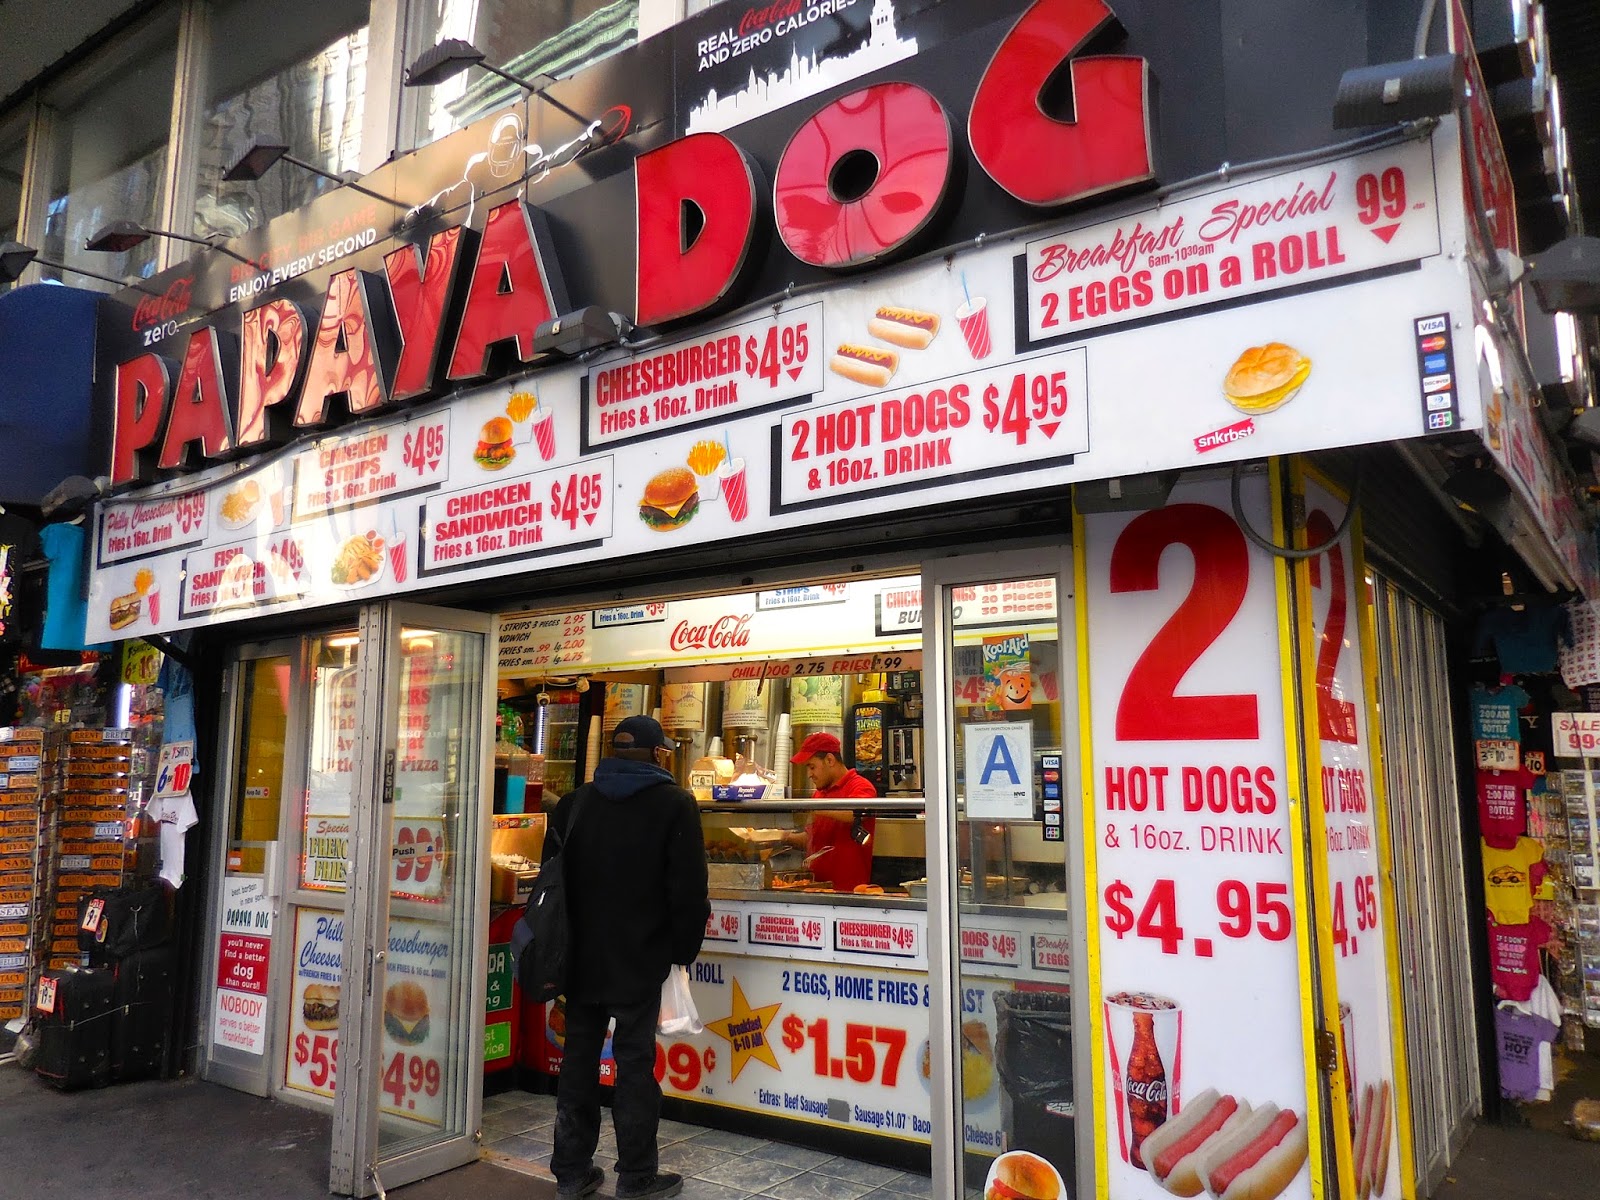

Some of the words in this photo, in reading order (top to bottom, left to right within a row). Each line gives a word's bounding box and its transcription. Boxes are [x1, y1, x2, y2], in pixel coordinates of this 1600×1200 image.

[698, 47, 730, 71] AND
[731, 28, 772, 58] ZERO
[775, 0, 857, 36] CALORIES
[698, 27, 738, 56] REAL
[1356, 167, 1407, 226] 99
[1032, 216, 1185, 283] Breakfast
[1199, 171, 1338, 242] Special
[110, 202, 557, 486] PAPAYA
[634, 0, 1155, 327] DOG
[229, 271, 272, 303] ENJOY
[272, 251, 316, 286] EVERY
[318, 228, 377, 265] SECOND
[1040, 293, 1059, 329] 2
[1069, 270, 1154, 322] EGGS
[1163, 263, 1209, 300] on
[1220, 256, 1243, 288] a
[1252, 226, 1346, 281] ROLL
[1421, 320, 1444, 331] VISA
[596, 335, 741, 408] CHEESEBURGER
[600, 409, 636, 435] Fries
[639, 406, 650, 426] &
[653, 395, 691, 422] 16oz.
[695, 380, 738, 412] Drink
[791, 419, 810, 461] 2
[816, 404, 876, 456] HOT
[881, 383, 971, 443] DOGS
[1199, 423, 1254, 448] snkrbst
[319, 434, 388, 469] CHICKEN
[325, 457, 381, 487] STRIPS
[807, 468, 821, 491] &
[826, 457, 878, 487] 16oz.
[884, 437, 952, 477] DRINK
[307, 487, 332, 507] Fries
[343, 480, 367, 500] 16oz.
[369, 472, 397, 494] Drink
[446, 481, 531, 518] CHICKEN
[107, 511, 129, 534] Philly
[435, 502, 543, 542] SANDWICH
[108, 536, 126, 555] Fries
[127, 536, 132, 549] &
[152, 523, 173, 546] Drink
[433, 540, 462, 562] Fries
[465, 540, 474, 556] &
[476, 534, 505, 554] 16oz.
[508, 525, 543, 547] Drink
[214, 547, 244, 568] FISH
[192, 561, 266, 591] SANDWICH
[1002, 579, 1052, 591] Pieces
[190, 590, 210, 607] Fries
[765, 597, 781, 605] Fries
[803, 593, 820, 602] Drink
[982, 595, 998, 604] 20
[1002, 591, 1053, 602] Pieces
[600, 613, 612, 623] Fries
[630, 609, 644, 619] Drink
[982, 606, 998, 615] 30
[1002, 603, 1053, 613] Pieces
[503, 620, 532, 632] STRIPS
[532, 620, 539, 630] 3
[540, 619, 561, 628] PIECES
[1110, 502, 1260, 742] 2
[1308, 509, 1358, 745] 2
[670, 613, 754, 653] Coca-Cola
[499, 645, 523, 656] FRIES
[553, 641, 562, 653] lg.
[563, 639, 585, 650] 2.00
[983, 633, 1030, 661] Kool-Aid
[498, 657, 520, 667] FRIES
[732, 665, 761, 679] CHILI
[795, 661, 825, 675] 2.75
[831, 658, 871, 672] FRIES
[1496, 710, 1510, 719] AM
[1482, 724, 1508, 733] BOTTLE
[1560, 720, 1600, 731] SALE
[400, 760, 439, 772] Pizza
[979, 735, 1021, 785] A
[157, 765, 169, 793] 6
[172, 763, 191, 792] 10
[384, 752, 394, 798] PUSH
[1105, 766, 1169, 812] HOT
[1182, 765, 1276, 815] DOGS
[1339, 768, 1367, 814] DOGS
[1486, 791, 1501, 799] 2:00
[1503, 791, 1515, 800] AM
[1489, 806, 1514, 815] BOTTLE
[1105, 824, 1121, 849] &
[1131, 823, 1190, 852] 16oz.
[1201, 825, 1284, 855] DRINK
[1347, 825, 1371, 851] DRINK
[392, 847, 415, 856] Push
[4, 859, 29, 867] SAM
[95, 859, 118, 867] CHRIS
[1, 892, 27, 900] SARA
[0, 908, 25, 916] SEAN
[226, 908, 252, 927] PAPAYA
[255, 911, 269, 928] DOG
[759, 916, 794, 926] CHICKEN
[1104, 878, 1292, 958] $4.95
[755, 924, 799, 935] SANDWICH
[755, 932, 767, 940] Fries
[785, 934, 799, 943] Drink
[839, 921, 891, 939] CHEESEBURGER
[962, 930, 989, 947] DOGS
[227, 939, 243, 948] you'll
[245, 941, 264, 951] never
[841, 938, 855, 946] Fries
[875, 940, 891, 950] Drink
[963, 947, 984, 958] DRINK
[224, 950, 237, 959] find
[244, 951, 266, 963] better
[1038, 952, 1045, 964] 2
[1046, 952, 1070, 966] EGGS
[233, 963, 254, 980] dog
[320, 971, 332, 981] FRIES
[397, 963, 410, 974] FRIES
[696, 963, 724, 984] ROLL
[225, 978, 240, 988] than
[490, 981, 500, 991] &
[782, 971, 791, 991] 2
[794, 972, 831, 1000] EGGS,
[835, 975, 874, 1001] HOME
[878, 979, 918, 1006] FRIES
[220, 995, 263, 1019] NOBODY
[220, 1017, 237, 1028] serves
[243, 1022, 261, 1034] better
[728, 1016, 763, 1038] Breakfast
[751, 1032, 764, 1048] AM
[1504, 1043, 1530, 1056] HOT
[781, 1013, 908, 1089] $1.57
[600, 1064, 611, 1075] 95
[759, 1088, 781, 1107] Extras:
[784, 1092, 799, 1110] Beef
[799, 1095, 829, 1117] Sausage
[854, 1104, 884, 1128] Sausage
[885, 1109, 906, 1130] $1.07
[965, 1123, 993, 1146] Cheese
